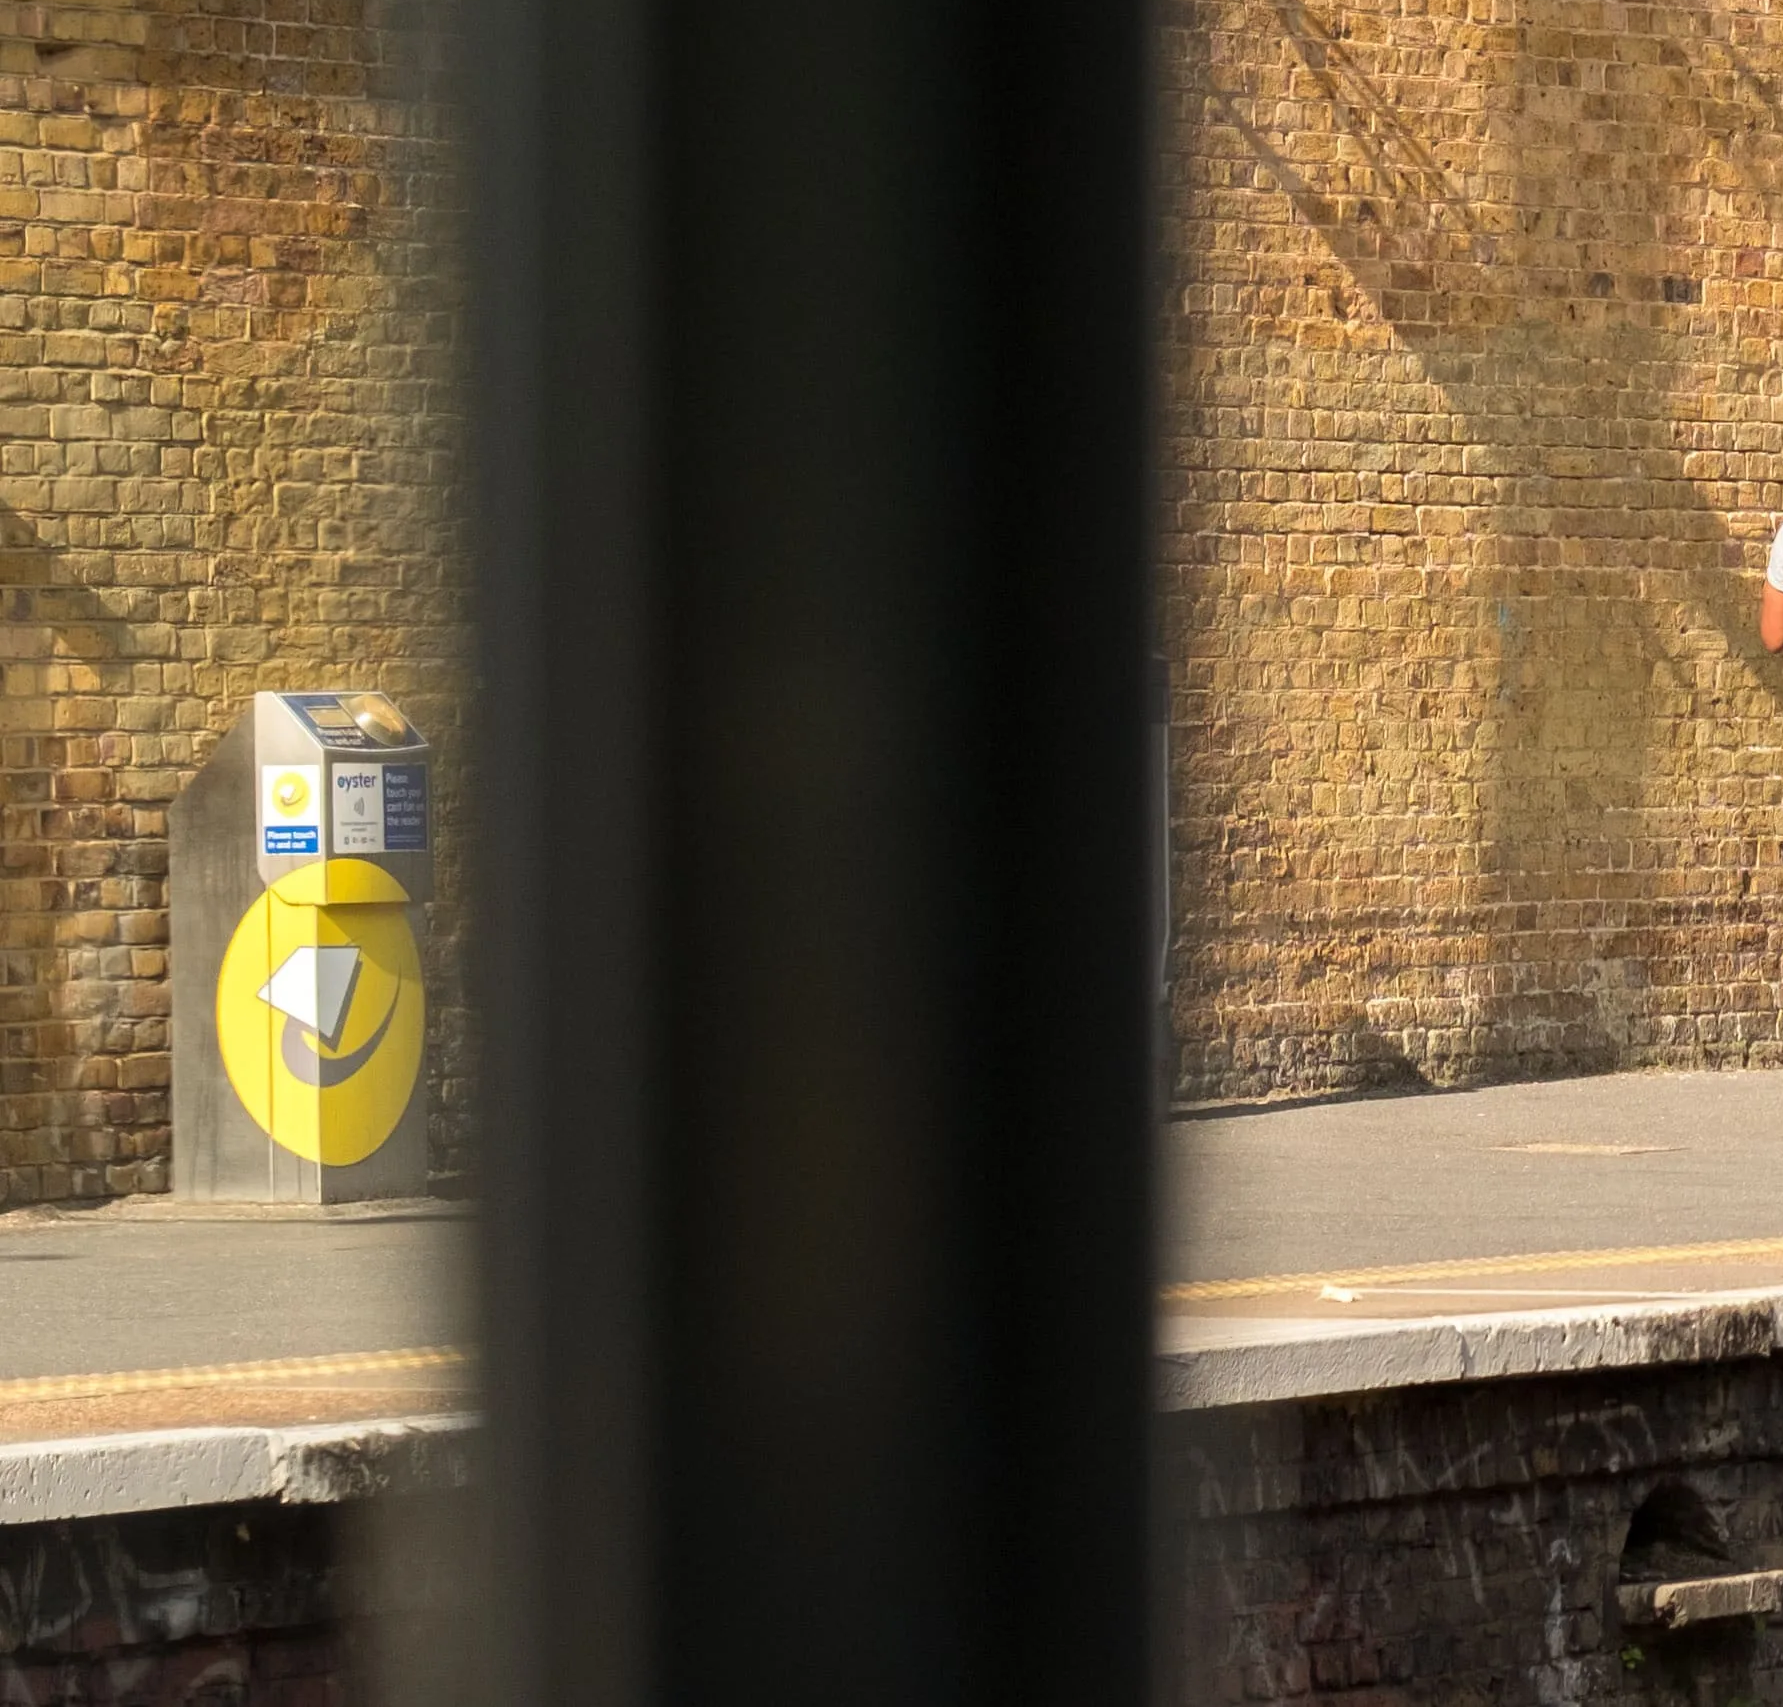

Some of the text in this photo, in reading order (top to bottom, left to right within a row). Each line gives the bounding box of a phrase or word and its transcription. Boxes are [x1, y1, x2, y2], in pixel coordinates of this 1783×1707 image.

[337, 772, 377, 792] oyster
[385, 772, 409, 783] Please
[386, 787, 407, 798] touch
[266, 829, 316, 840] Please touch
